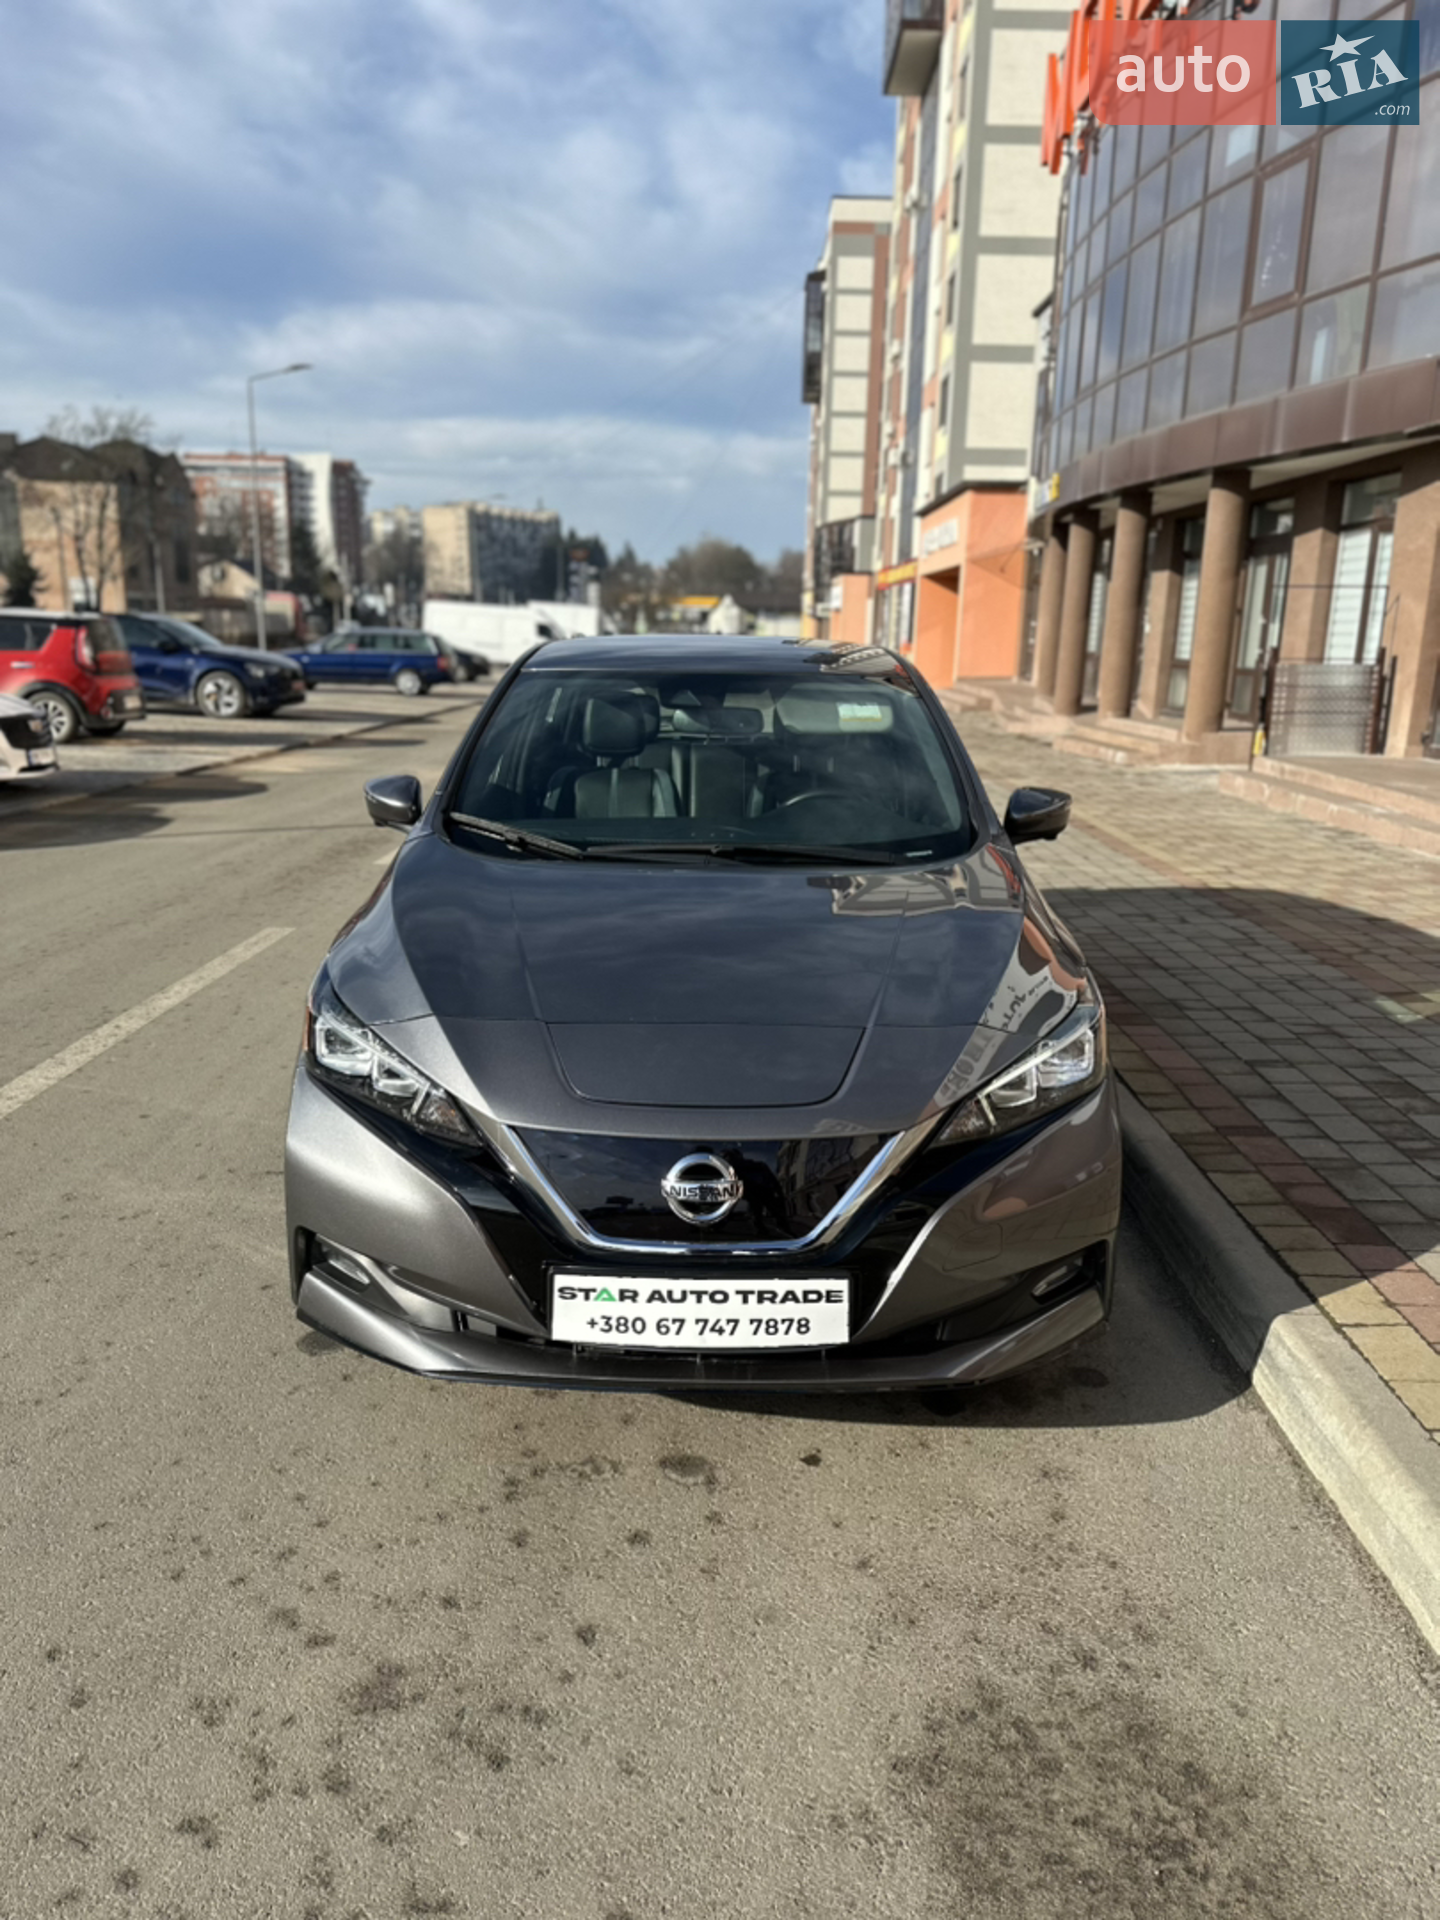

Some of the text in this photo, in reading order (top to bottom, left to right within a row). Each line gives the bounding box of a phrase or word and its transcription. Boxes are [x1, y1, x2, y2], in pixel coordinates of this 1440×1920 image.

[669, 1184, 736, 1199] NISSAN
[557, 1286, 844, 1305] STAR AUTO TRADE
[586, 1316, 811, 1336] +380 67 747 7878
